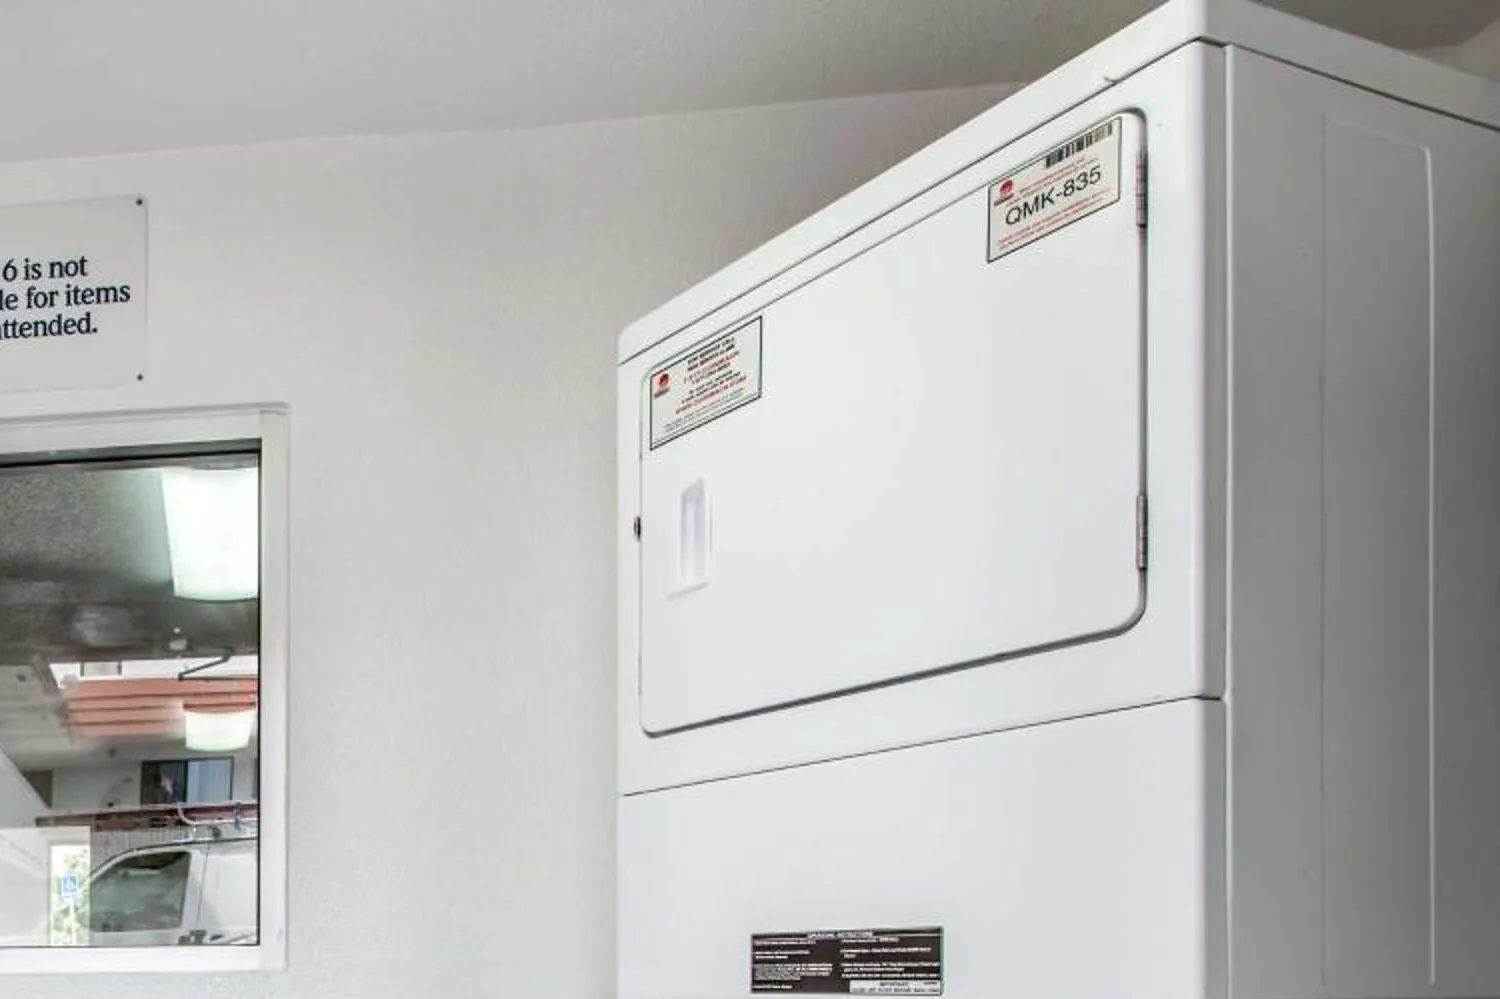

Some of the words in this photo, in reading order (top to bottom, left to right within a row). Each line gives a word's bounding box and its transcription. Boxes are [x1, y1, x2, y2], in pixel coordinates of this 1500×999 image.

[1005, 164, 1102, 225] QMK-835
[2, 259, 18, 282] 6
[24, 257, 43, 282] is
[49, 256, 88, 279] not
[26, 287, 58, 309] for
[65, 284, 131, 306] items
